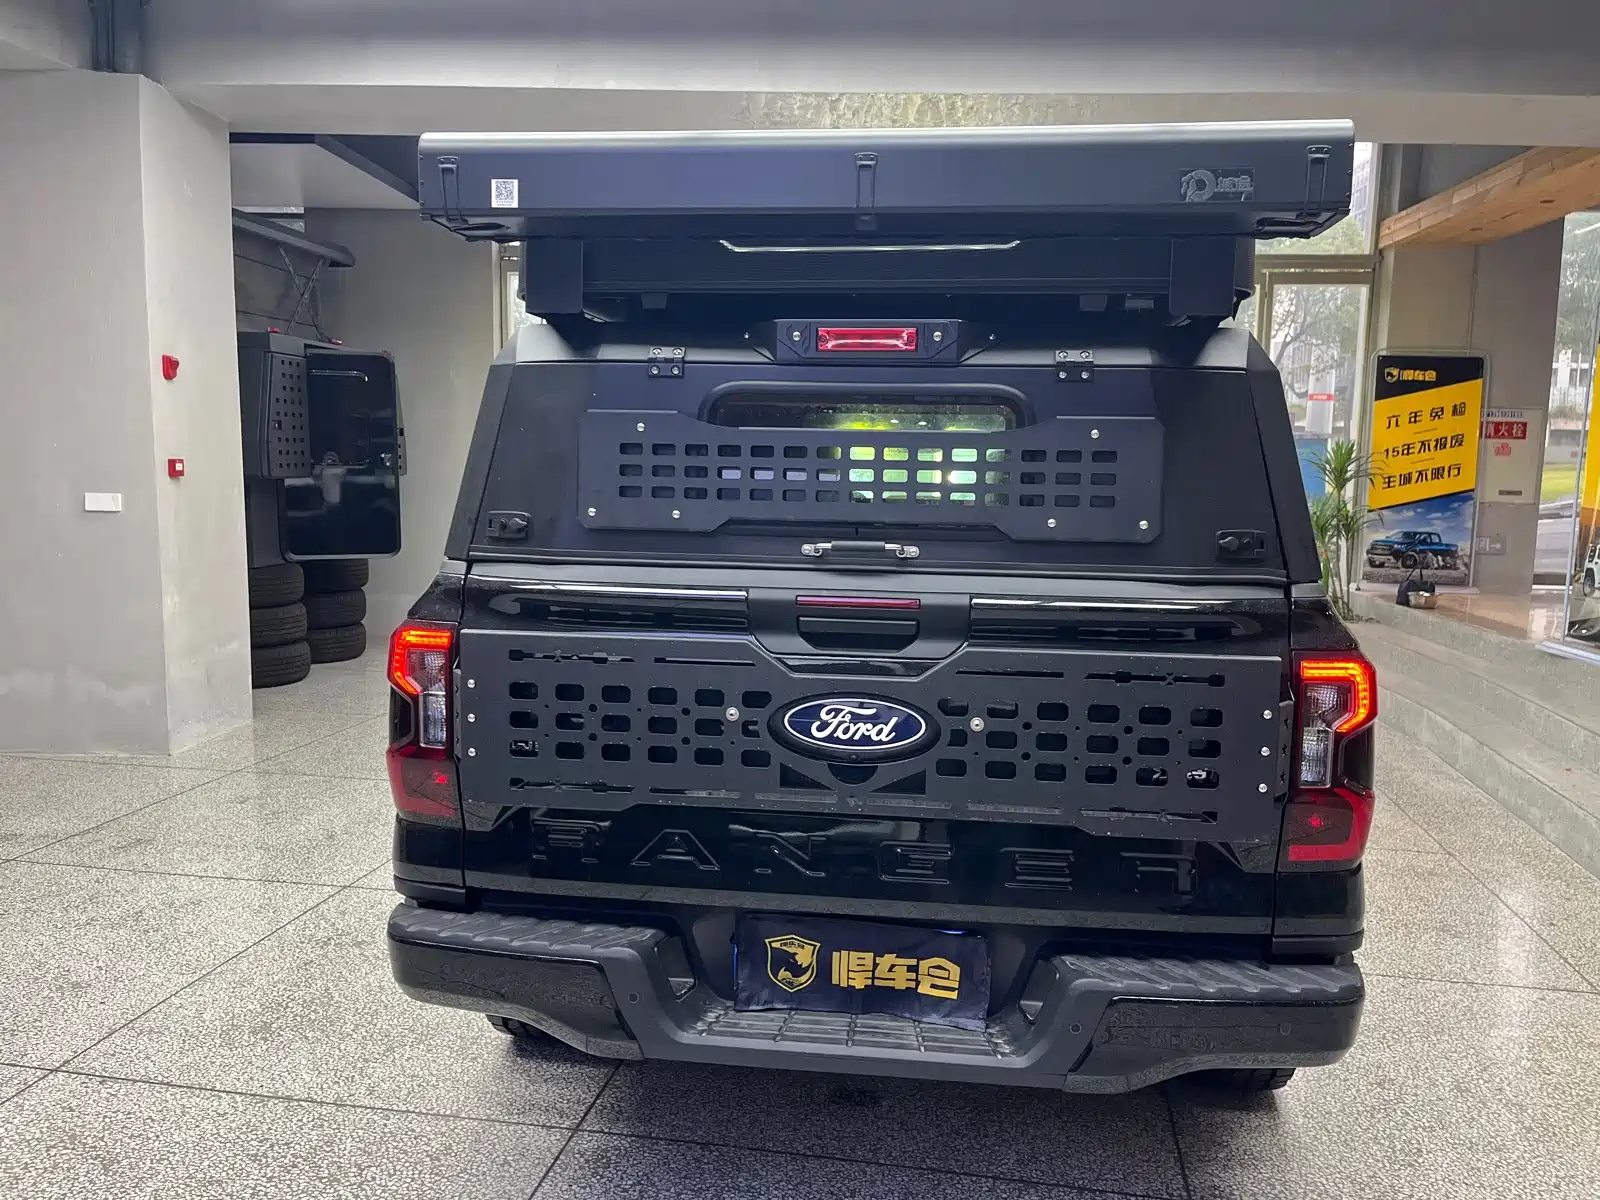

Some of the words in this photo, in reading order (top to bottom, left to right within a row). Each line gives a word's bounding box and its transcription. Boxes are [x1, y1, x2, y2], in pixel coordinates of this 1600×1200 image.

[1386, 402, 1466, 429] 六年免检
[1384, 434, 1464, 459] 15年不报废
[810, 705, 898, 742] Ford
[831, 950, 961, 1000] 悍车仓
